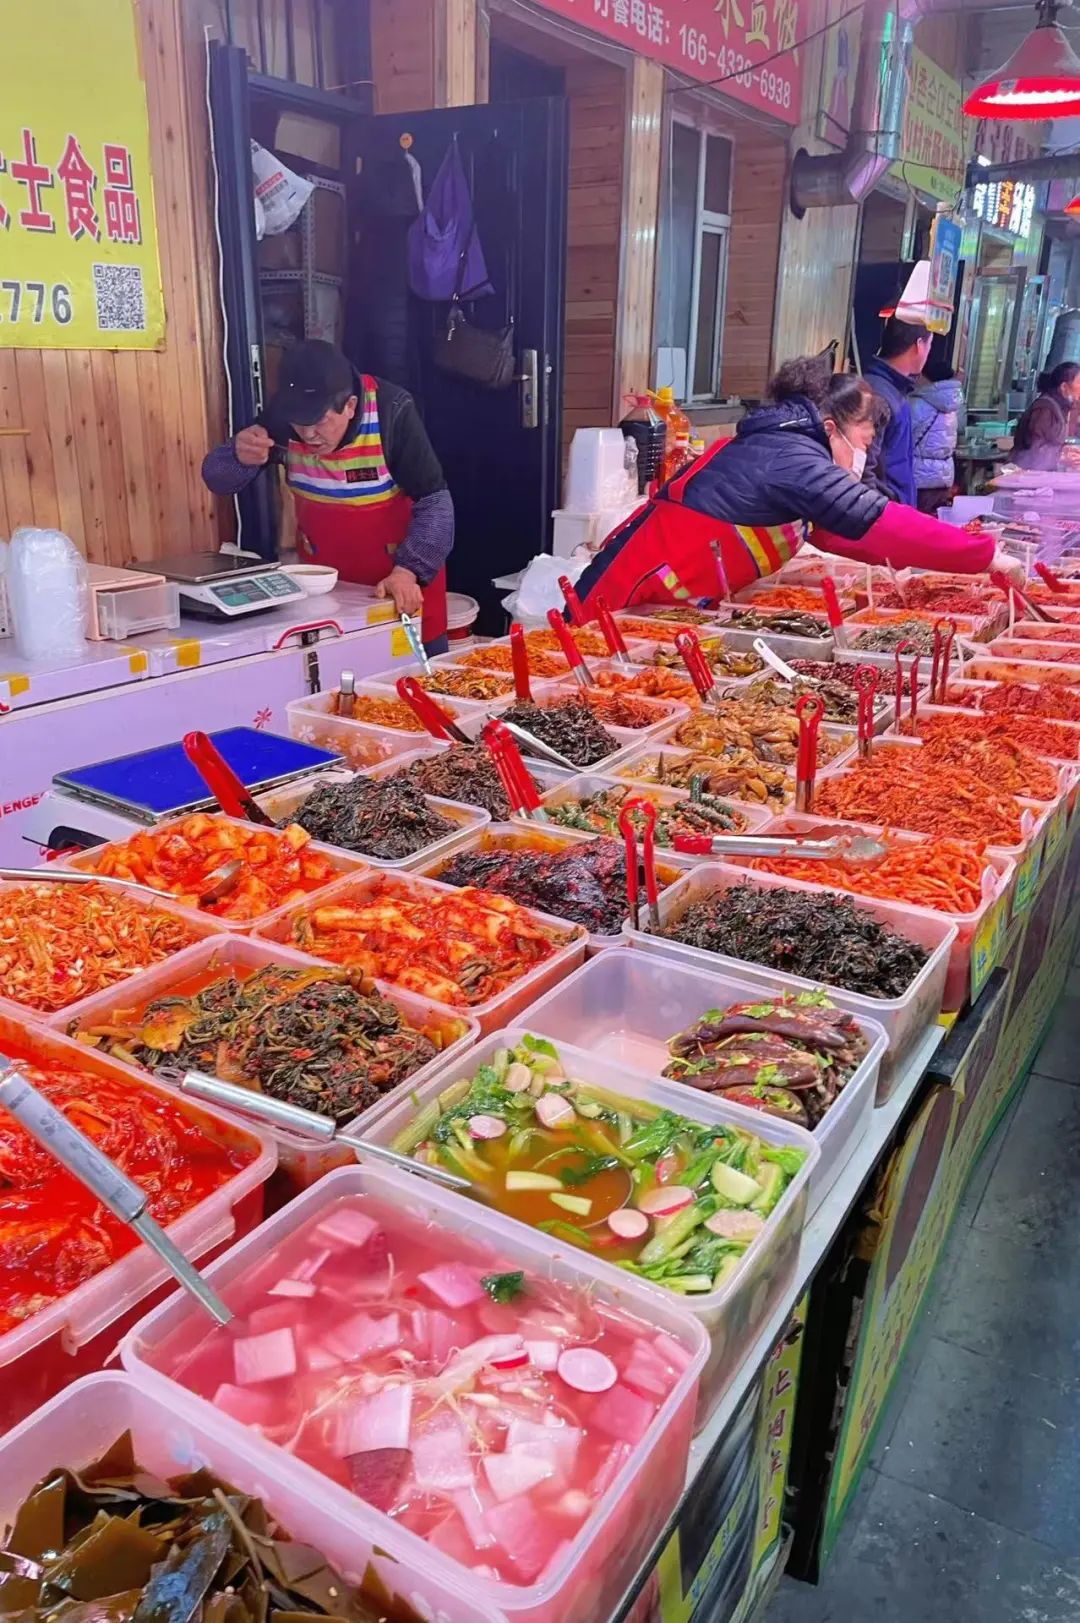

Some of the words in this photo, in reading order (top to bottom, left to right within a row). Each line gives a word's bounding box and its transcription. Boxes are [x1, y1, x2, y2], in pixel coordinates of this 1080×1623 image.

[0, 128, 143, 244] 士食品
[0, 281, 72, 323] 776
